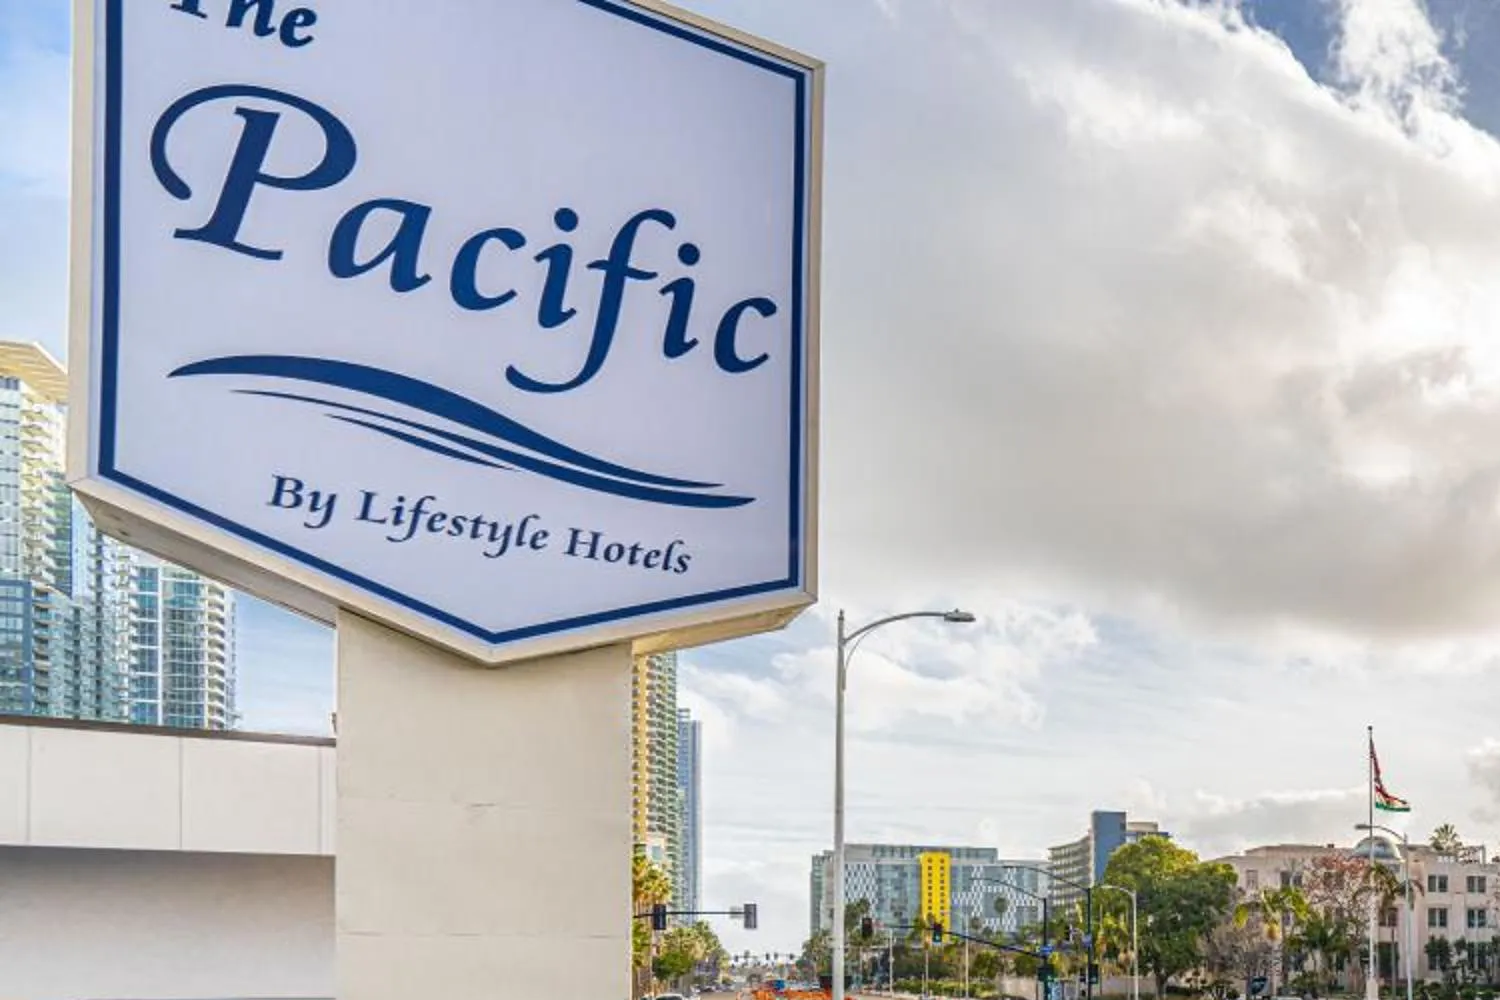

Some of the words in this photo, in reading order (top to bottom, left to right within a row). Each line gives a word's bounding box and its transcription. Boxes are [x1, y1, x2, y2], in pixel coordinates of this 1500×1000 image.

[170, 0, 318, 49] he
[149, 83, 778, 394] Pacific
[268, 474, 338, 530] By
[355, 489, 549, 560] Lifestyle
[562, 526, 693, 575] Hotels
